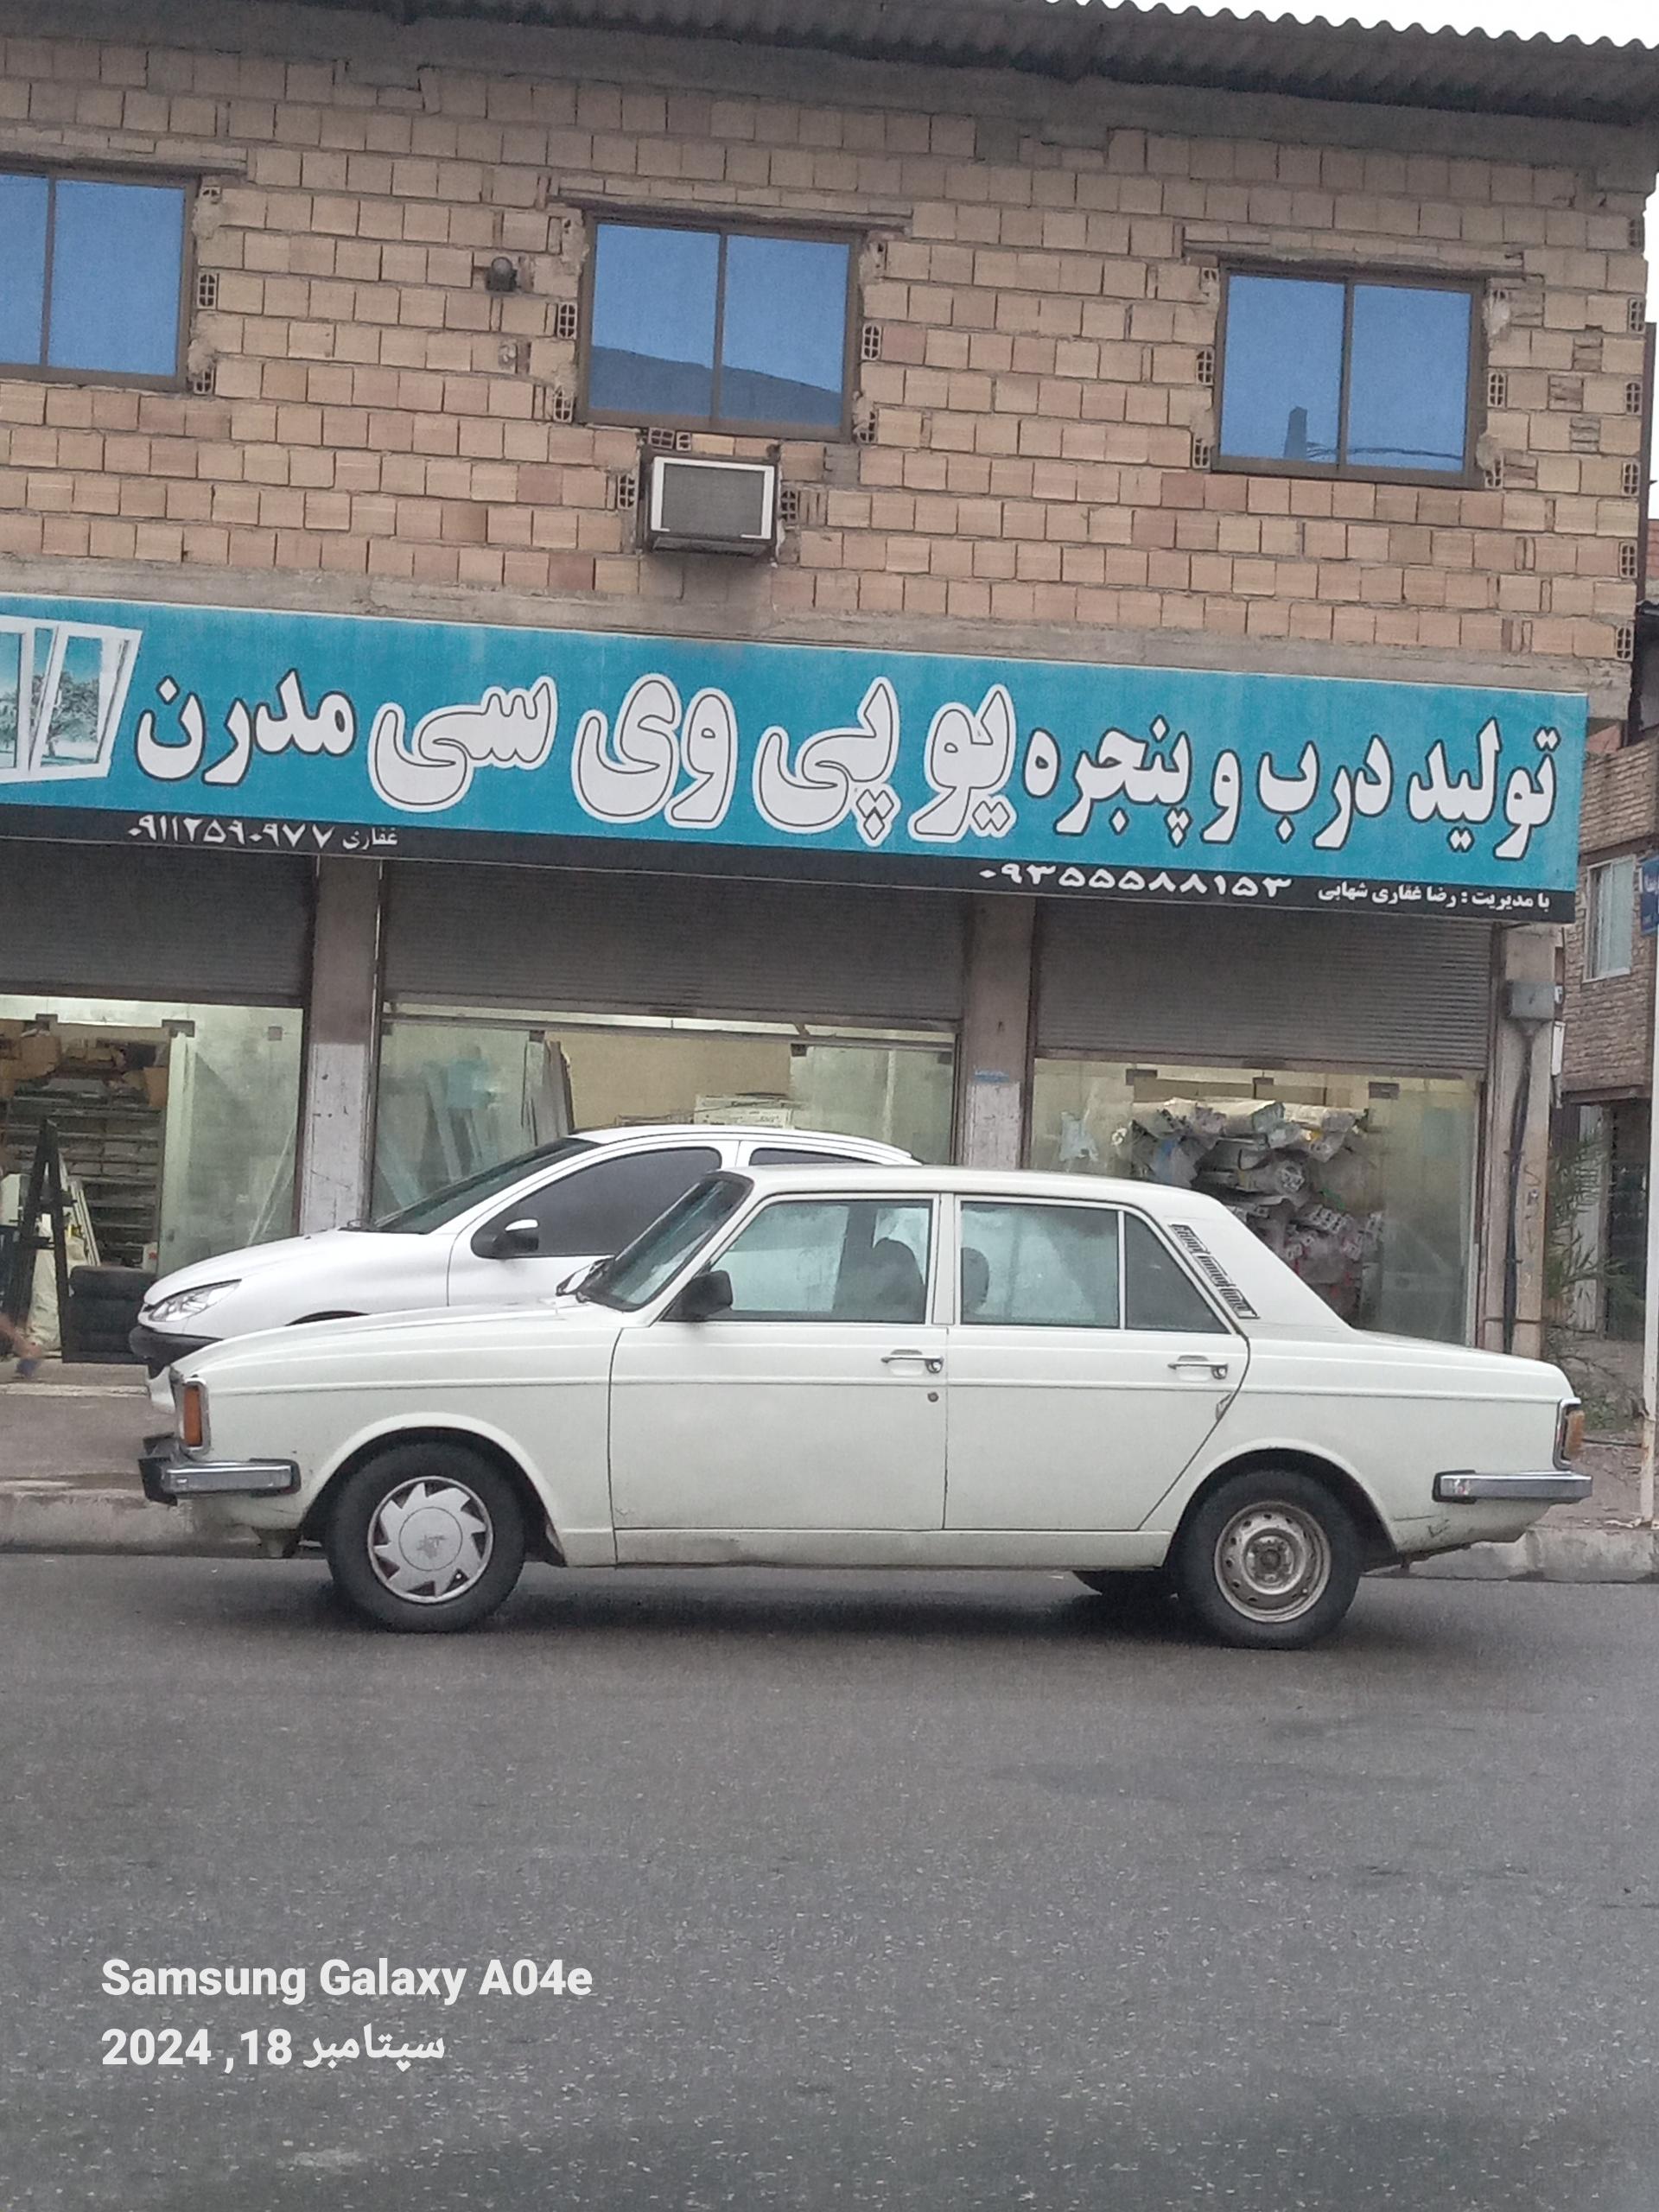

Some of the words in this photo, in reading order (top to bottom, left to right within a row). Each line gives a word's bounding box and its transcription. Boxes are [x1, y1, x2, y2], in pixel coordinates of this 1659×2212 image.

[135, 668, 357, 788] مدرن
[367, 675, 558, 812] سی
[570, 672, 740, 830] وی
[752, 676, 901, 847] پی
[907, 683, 1017, 843] یو
[1023, 715, 1192, 847] پنجره
[1202, 749, 1243, 843] و
[1256, 734, 1395, 851] درب
[1407, 717, 1560, 861] تولید
[980, 862, 1293, 899] ۰۹۳۵۵۵۸۸۱۵۳
[1318, 881, 1368, 900] شهابی
[1371, 885, 1422, 906] غفاری
[1427, 887, 1457, 907] رضا
[1471, 890, 1534, 911] مدیریت
[1538, 892, 1551, 913] با
